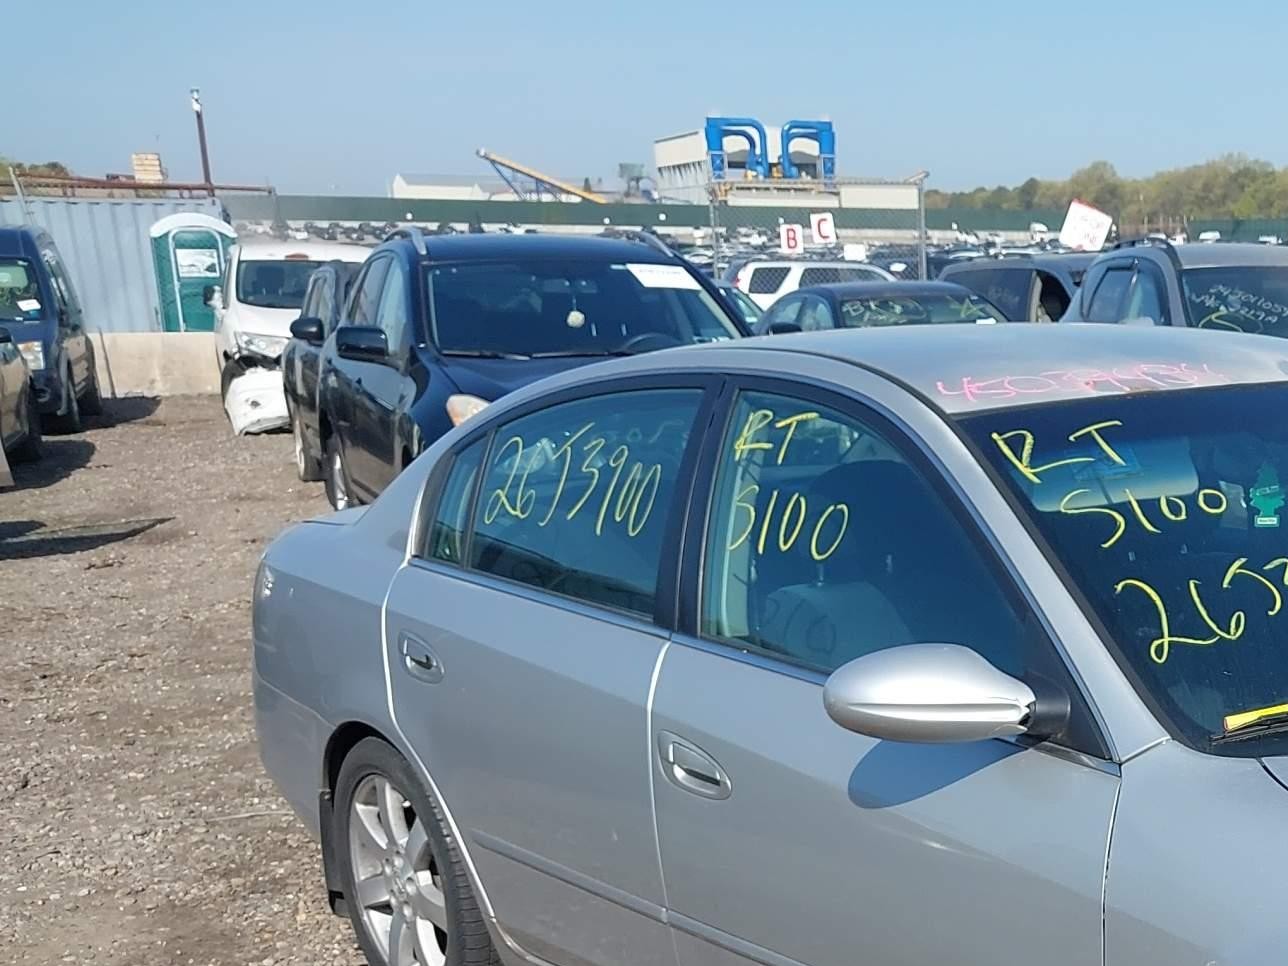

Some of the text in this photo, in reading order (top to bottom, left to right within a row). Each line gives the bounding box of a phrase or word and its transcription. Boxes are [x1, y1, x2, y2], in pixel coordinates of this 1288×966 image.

[787, 228, 797, 249] B
[818, 218, 830, 239] C
[735, 409, 820, 465] RT
[991, 420, 1123, 484] RT
